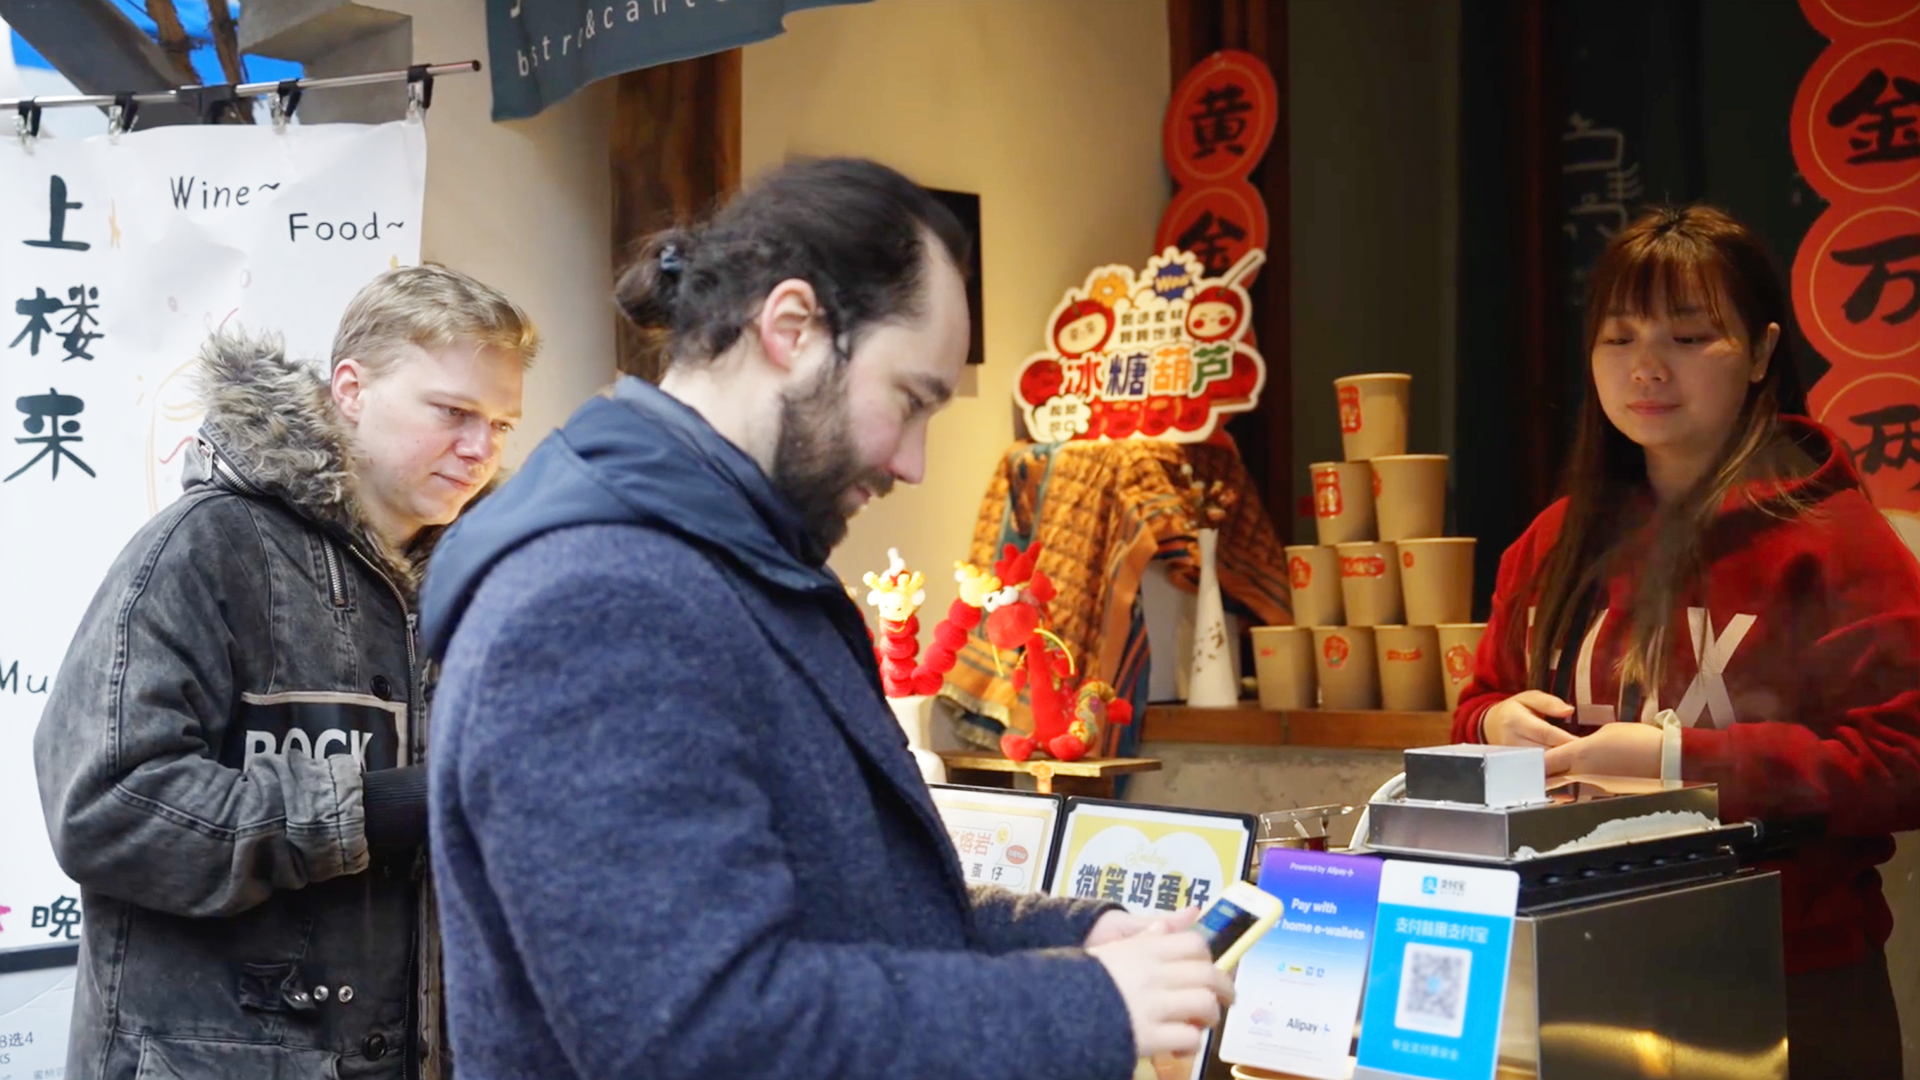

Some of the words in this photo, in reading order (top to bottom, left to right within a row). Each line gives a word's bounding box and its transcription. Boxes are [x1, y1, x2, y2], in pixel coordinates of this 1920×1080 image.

[2, 174, 105, 484] 上楼来
[1062, 344, 1232, 398] 冰糖葫芦
[244, 727, 373, 773] ROCK
[1290, 861, 1317, 872] Powered
[1075, 864, 1210, 911] 微笑鸡蛋仔
[1291, 898, 1312, 914] Pay
[1313, 901, 1337, 914] with
[1282, 918, 1313, 933] home
[1314, 925, 1365, 940] e-wallets
[1395, 917, 1489, 944] 支付就用支付宝
